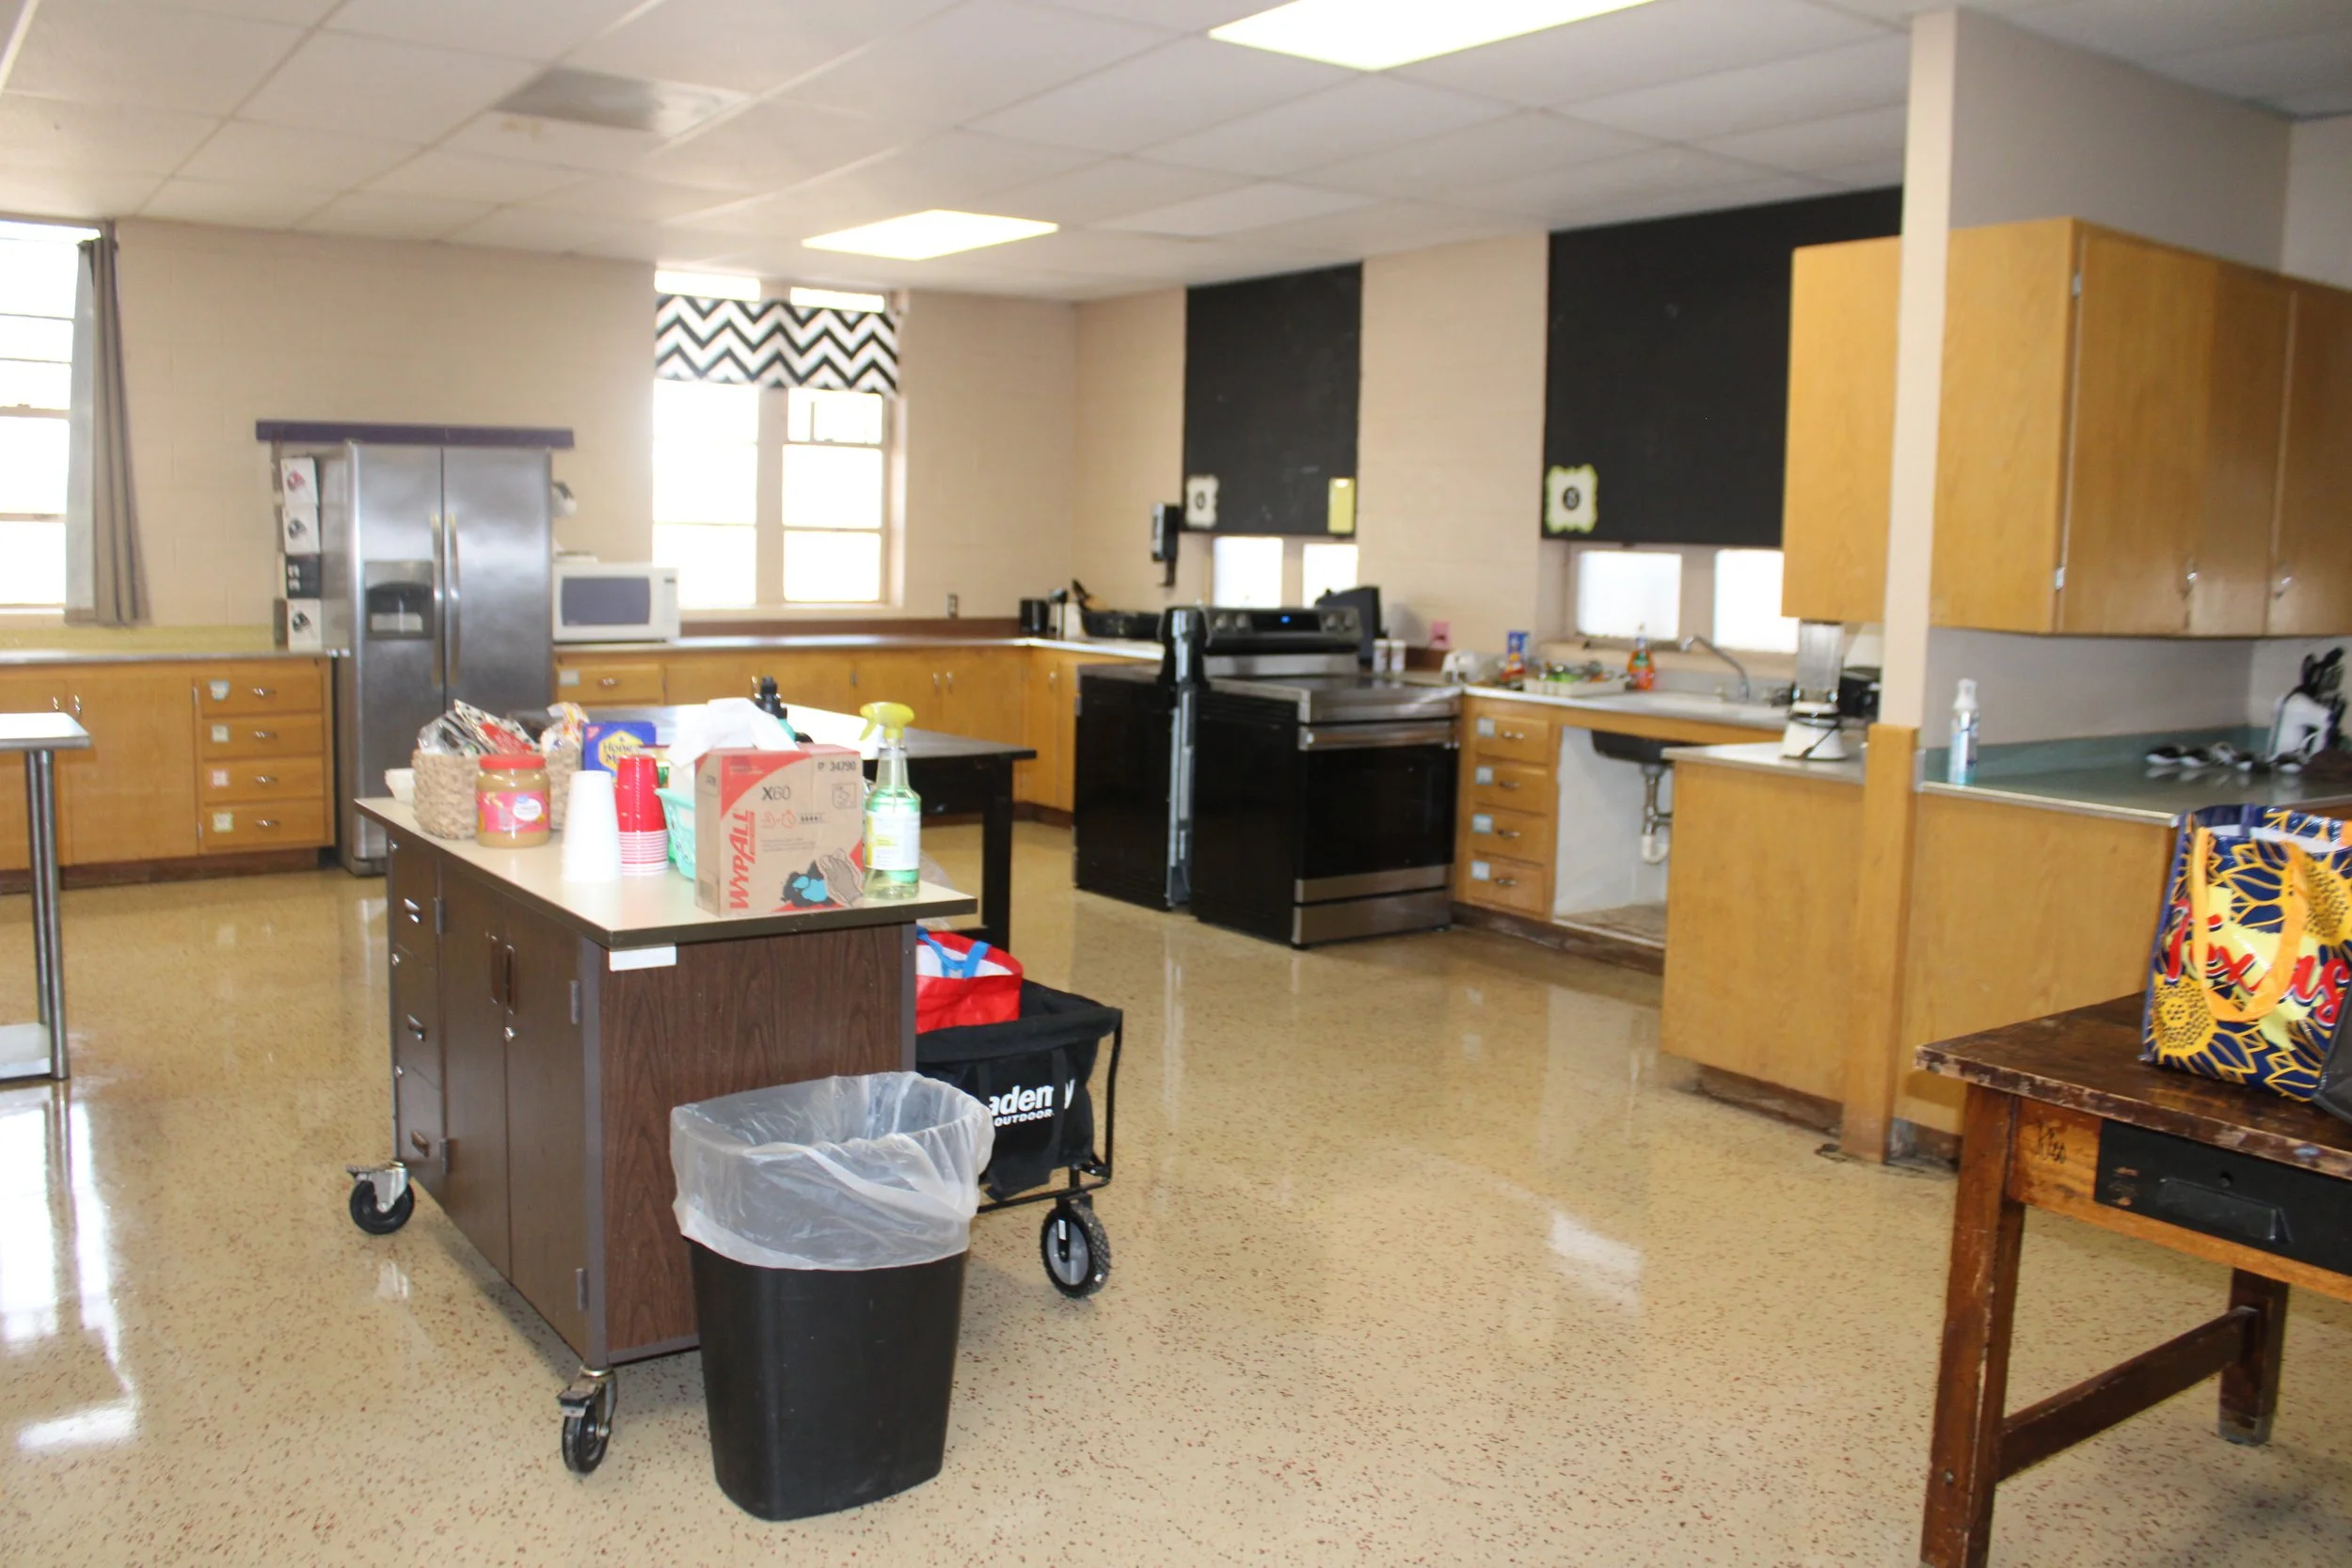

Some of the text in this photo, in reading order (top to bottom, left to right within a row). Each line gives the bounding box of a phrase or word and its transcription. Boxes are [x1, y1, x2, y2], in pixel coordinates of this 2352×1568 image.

[761, 785, 791, 800] X60
[989, 1078, 1075, 1117] ademy
[993, 1108, 1055, 1128] OUTDOOR
